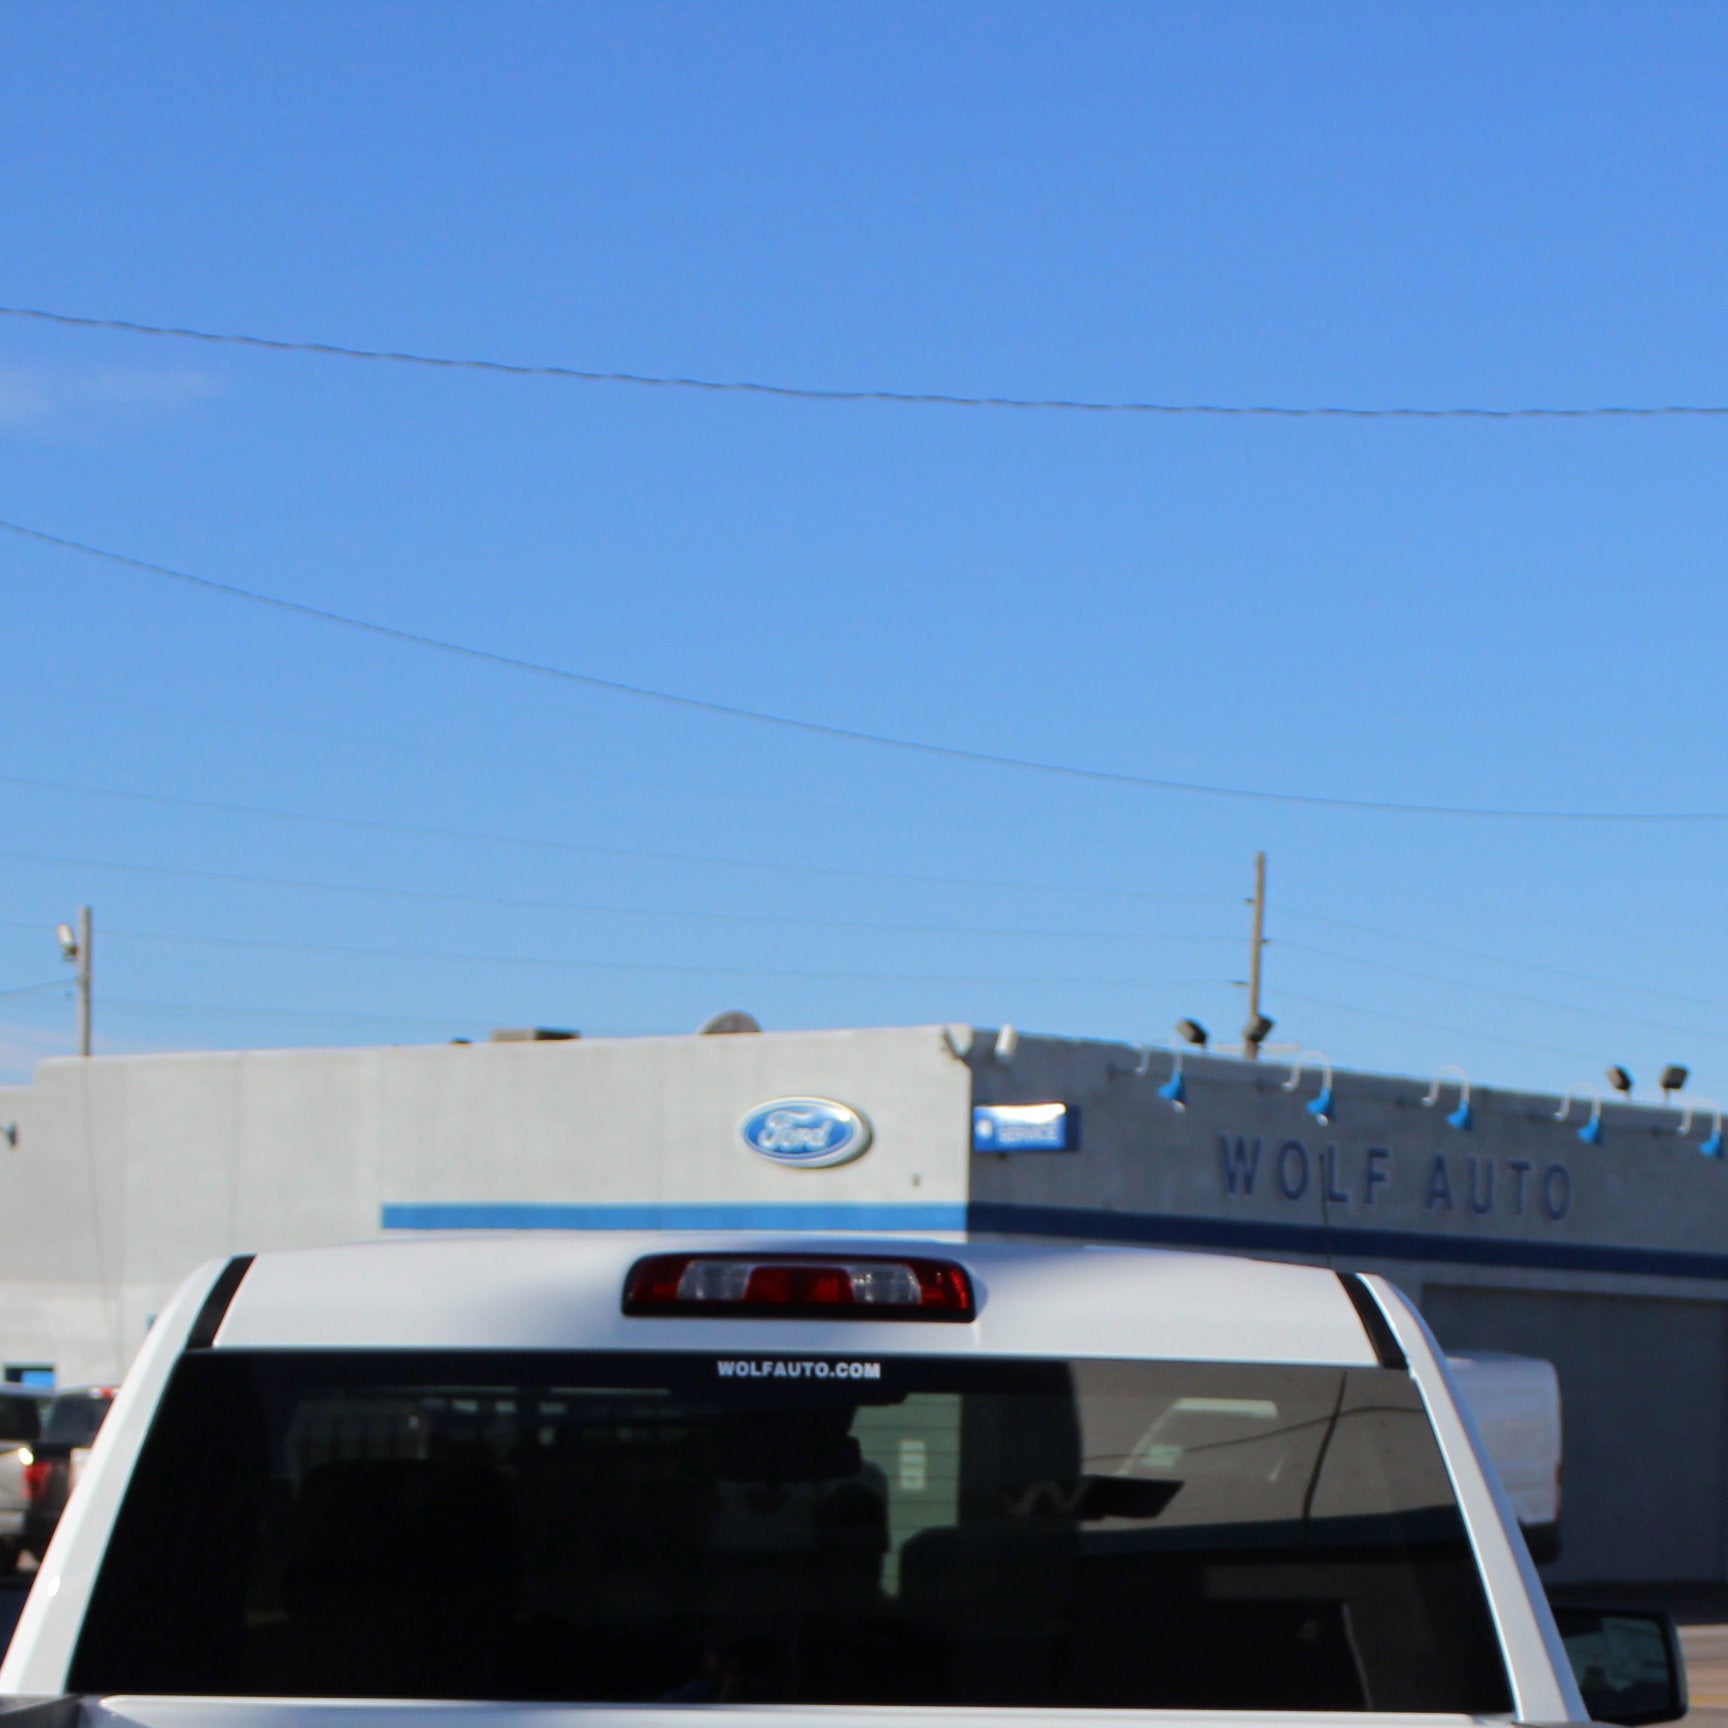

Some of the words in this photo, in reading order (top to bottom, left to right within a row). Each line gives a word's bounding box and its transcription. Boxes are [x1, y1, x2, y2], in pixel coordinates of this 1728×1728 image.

[757, 1109, 833, 1148] Ford
[1218, 1132, 1389, 1206] WOLF
[1425, 1151, 1572, 1222] AUTO
[717, 1360, 881, 1379] WOLFAUTO.COM
